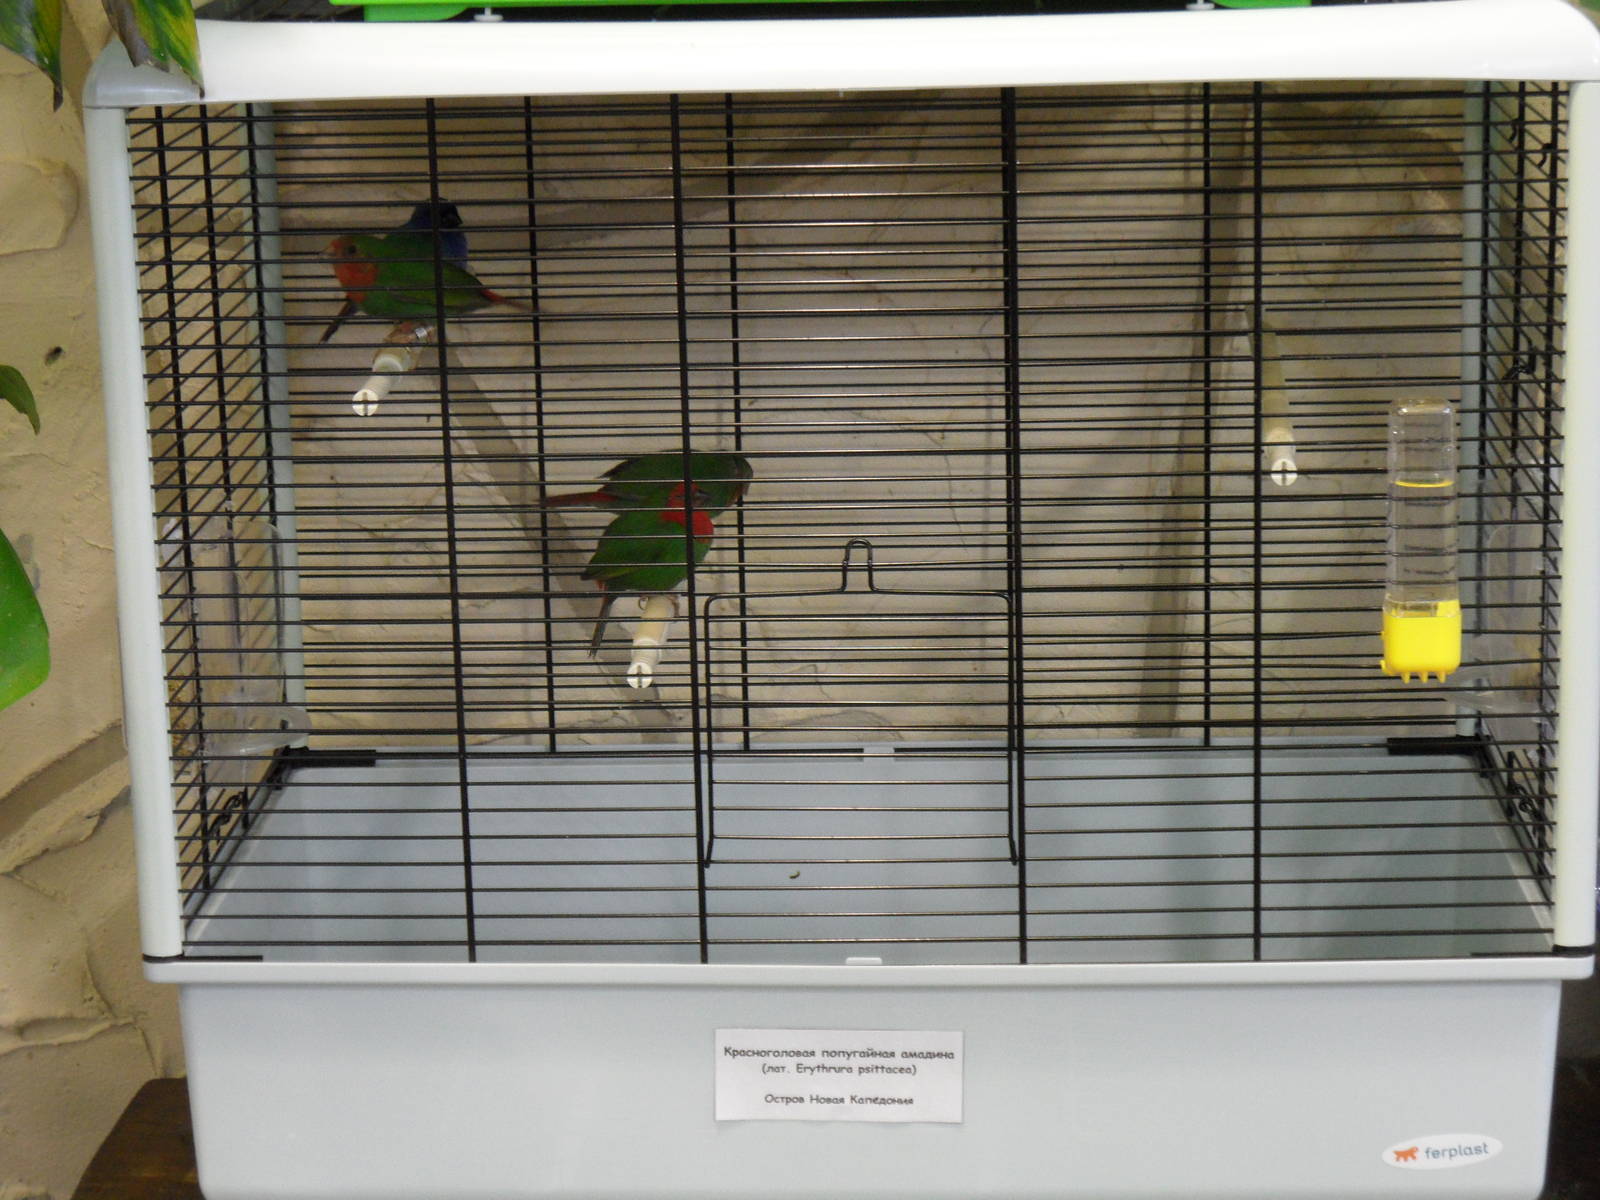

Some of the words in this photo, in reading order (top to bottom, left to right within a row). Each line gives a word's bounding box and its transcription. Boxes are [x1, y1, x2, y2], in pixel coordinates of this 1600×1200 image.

[723, 1046, 816, 1059] Красноголовая
[821, 1048, 896, 1060] попугайная
[900, 1050, 955, 1060] амадина
[796, 1063, 853, 1075] Erythrura
[858, 1064, 917, 1076] psittacea)
[764, 1093, 805, 1106] Остров
[809, 1094, 845, 1105] Новая
[849, 1095, 914, 1106] Каледония
[1424, 1142, 1489, 1160] ferplast
